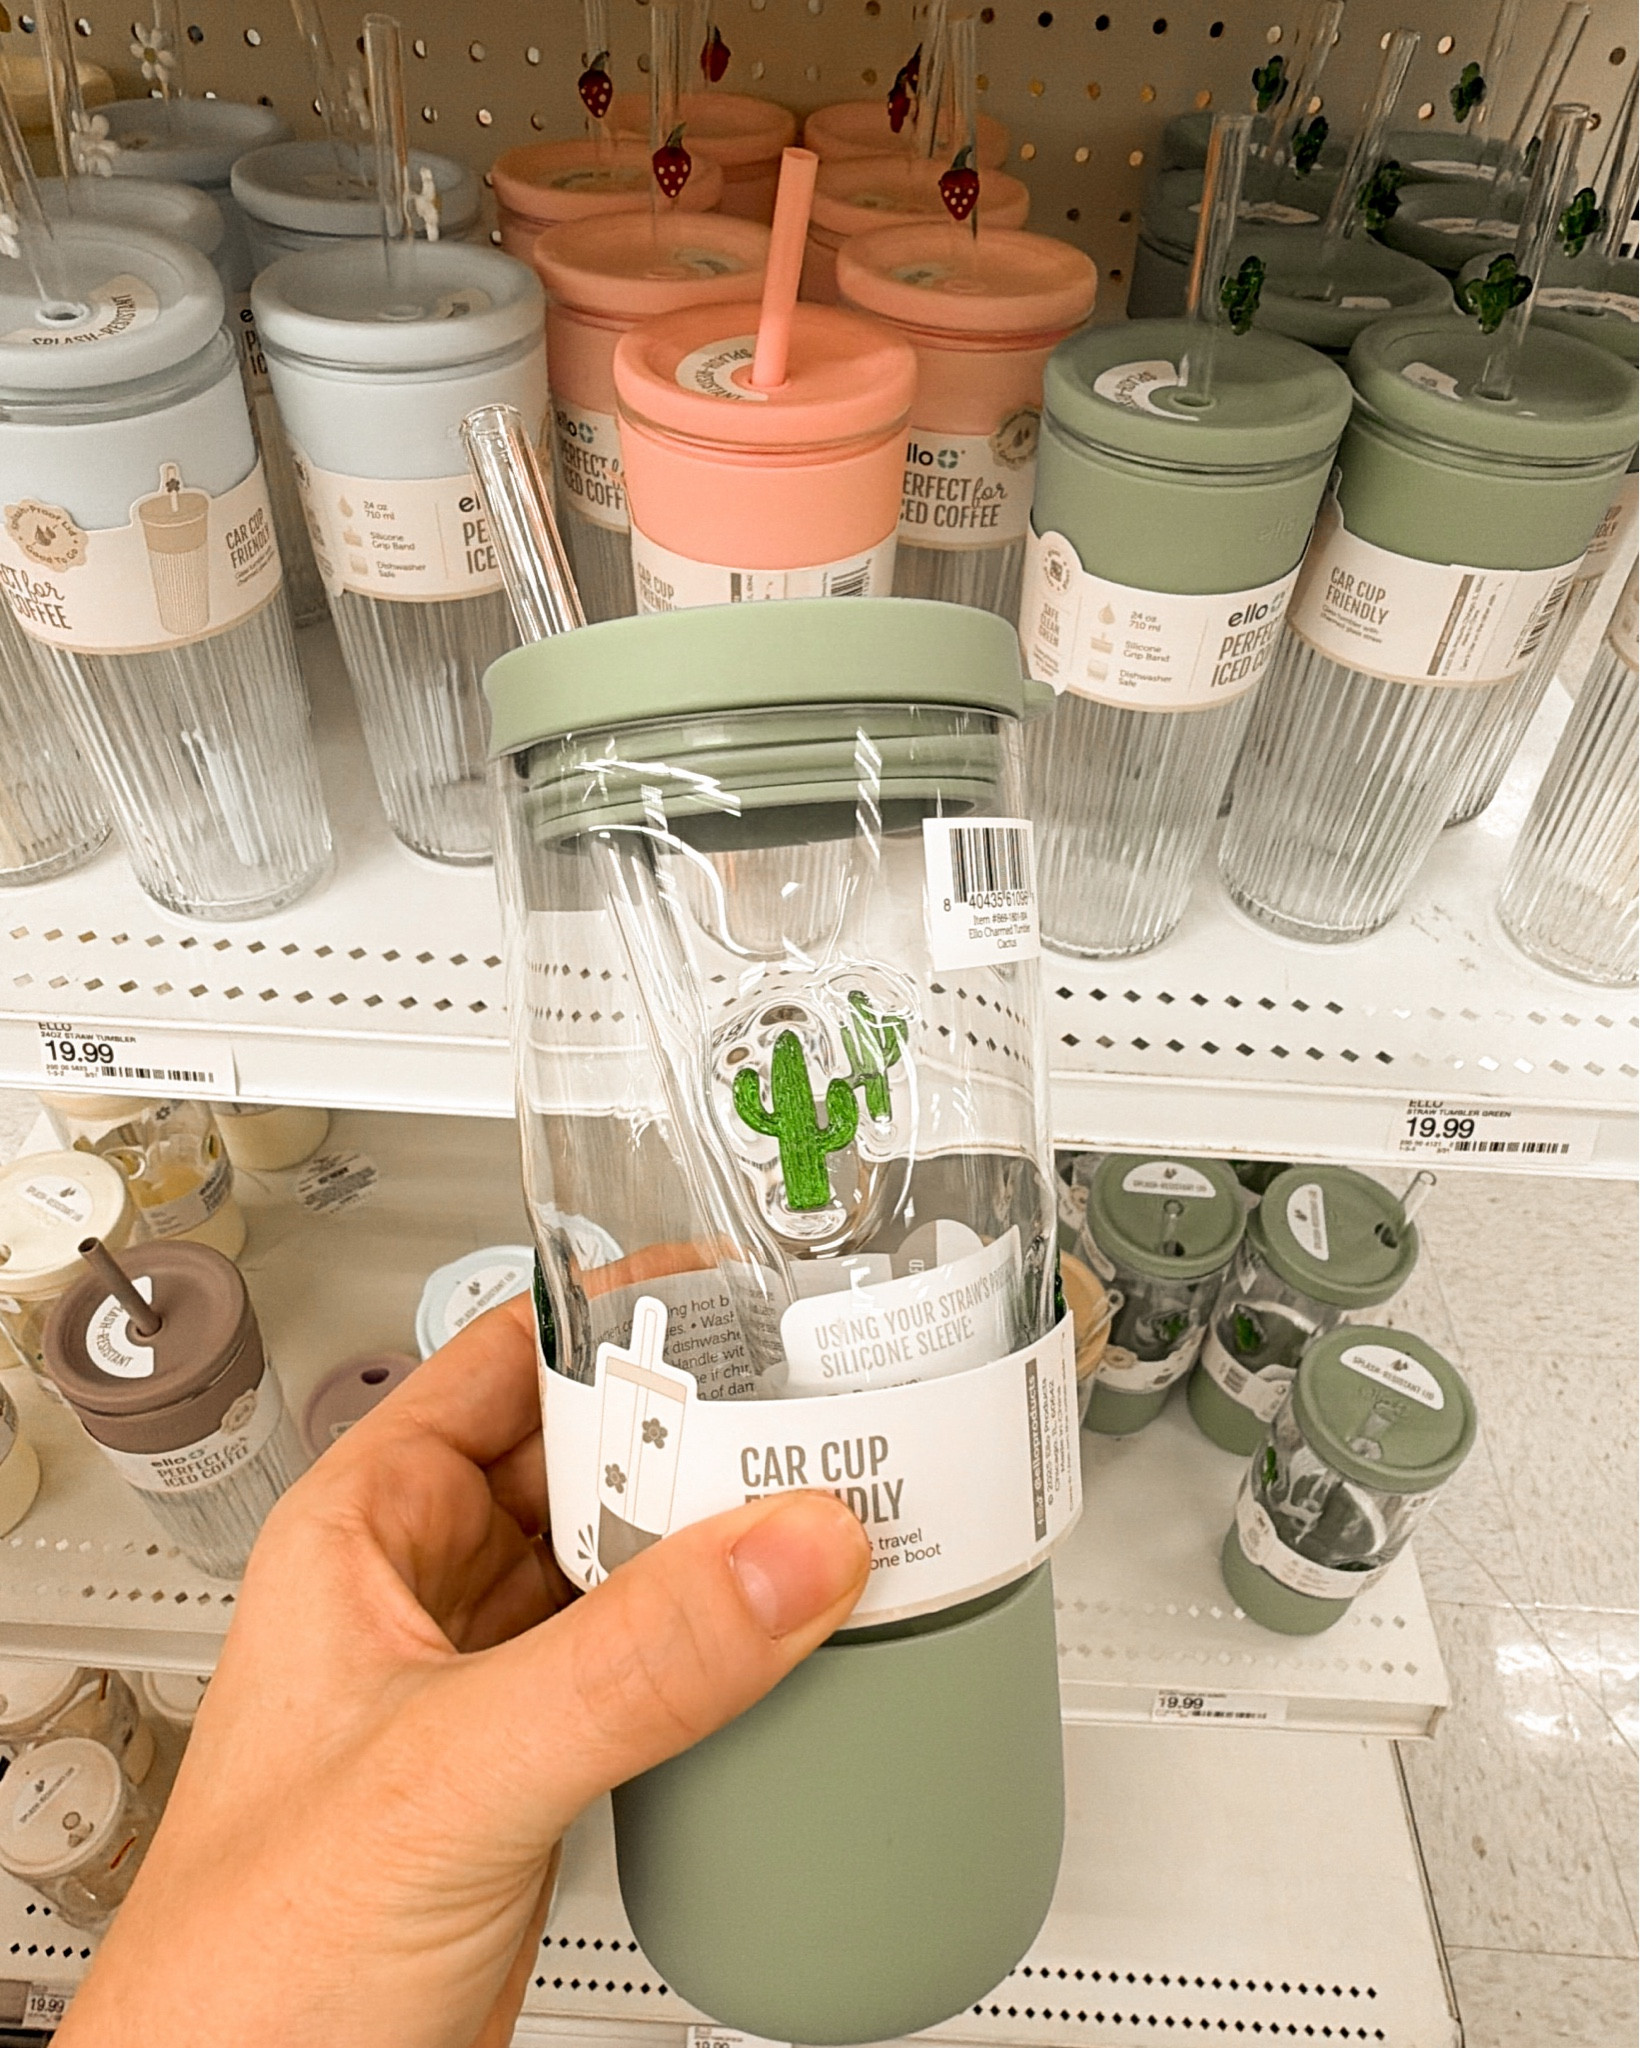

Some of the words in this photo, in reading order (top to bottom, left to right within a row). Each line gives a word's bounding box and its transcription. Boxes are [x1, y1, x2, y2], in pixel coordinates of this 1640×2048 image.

[905, 442, 934, 466] llo
[902, 471, 972, 502] ERFECT
[971, 477, 1008, 509] for
[363, 501, 376, 511] 24
[364, 510, 381, 520] 710
[933, 504, 1002, 528] COFFEE
[225, 524, 249, 550] CAR
[248, 507, 264, 535] CUP
[230, 522, 270, 569] FRIENDLY
[466, 545, 500, 574] ICE
[21, 570, 65, 604] for
[653, 576, 675, 601] CUP
[1330, 566, 1355, 592] CAR
[1356, 580, 1386, 604] CUP
[1228, 602, 1269, 627] ello
[1325, 584, 1389, 625] FRIENDLY
[1129, 620, 1146, 630] 710
[1148, 623, 1162, 633] ml
[1130, 611, 1143, 620] 24
[1145, 614, 1157, 622] oz
[1123, 650, 1144, 661] Grip
[1145, 652, 1170, 663] Band
[1125, 641, 1162, 653] Silicone
[1119, 669, 1173, 683] Dishwasher
[1210, 655, 1253, 688] ICED
[1118, 678, 1137, 688] Safe
[943, 898, 952, 912] 8
[968, 892, 1004, 910] 40435
[973, 914, 991, 926] Item
[968, 928, 983, 940] Ello
[983, 926, 1013, 938] Charmed
[996, 938, 1018, 949] Cactus
[64, 1033, 94, 1041] STRAW
[95, 1034, 137, 1044] TUMBLER
[45, 1040, 115, 1064] 19.99
[1439, 1109, 1479, 1117] TUMBLER
[1406, 1117, 1475, 1139] 19.99
[667, 1304, 688, 1319] ing
[691, 1298, 716, 1312] hot
[814, 1316, 880, 1351] USING
[883, 1301, 934, 1335] YOUR
[938, 1277, 991, 1319] STRAW'S
[722, 1345, 745, 1360] wit
[820, 1336, 914, 1379] SILICONE
[710, 1384, 724, 1399] of
[1042, 1377, 1050, 1433] Products
[150, 1457, 187, 1467] ello
[157, 1452, 221, 1478] PERFECT
[741, 1445, 809, 1487] CAR
[821, 1435, 888, 1482] CUP
[164, 1474, 199, 1488] ICED
[878, 1528, 923, 1551] travel
[870, 1555, 900, 1571] one
[904, 1543, 942, 1564] boot
[1158, 1696, 1204, 1710] 19.99
[31, 1997, 65, 2014] 19.99
